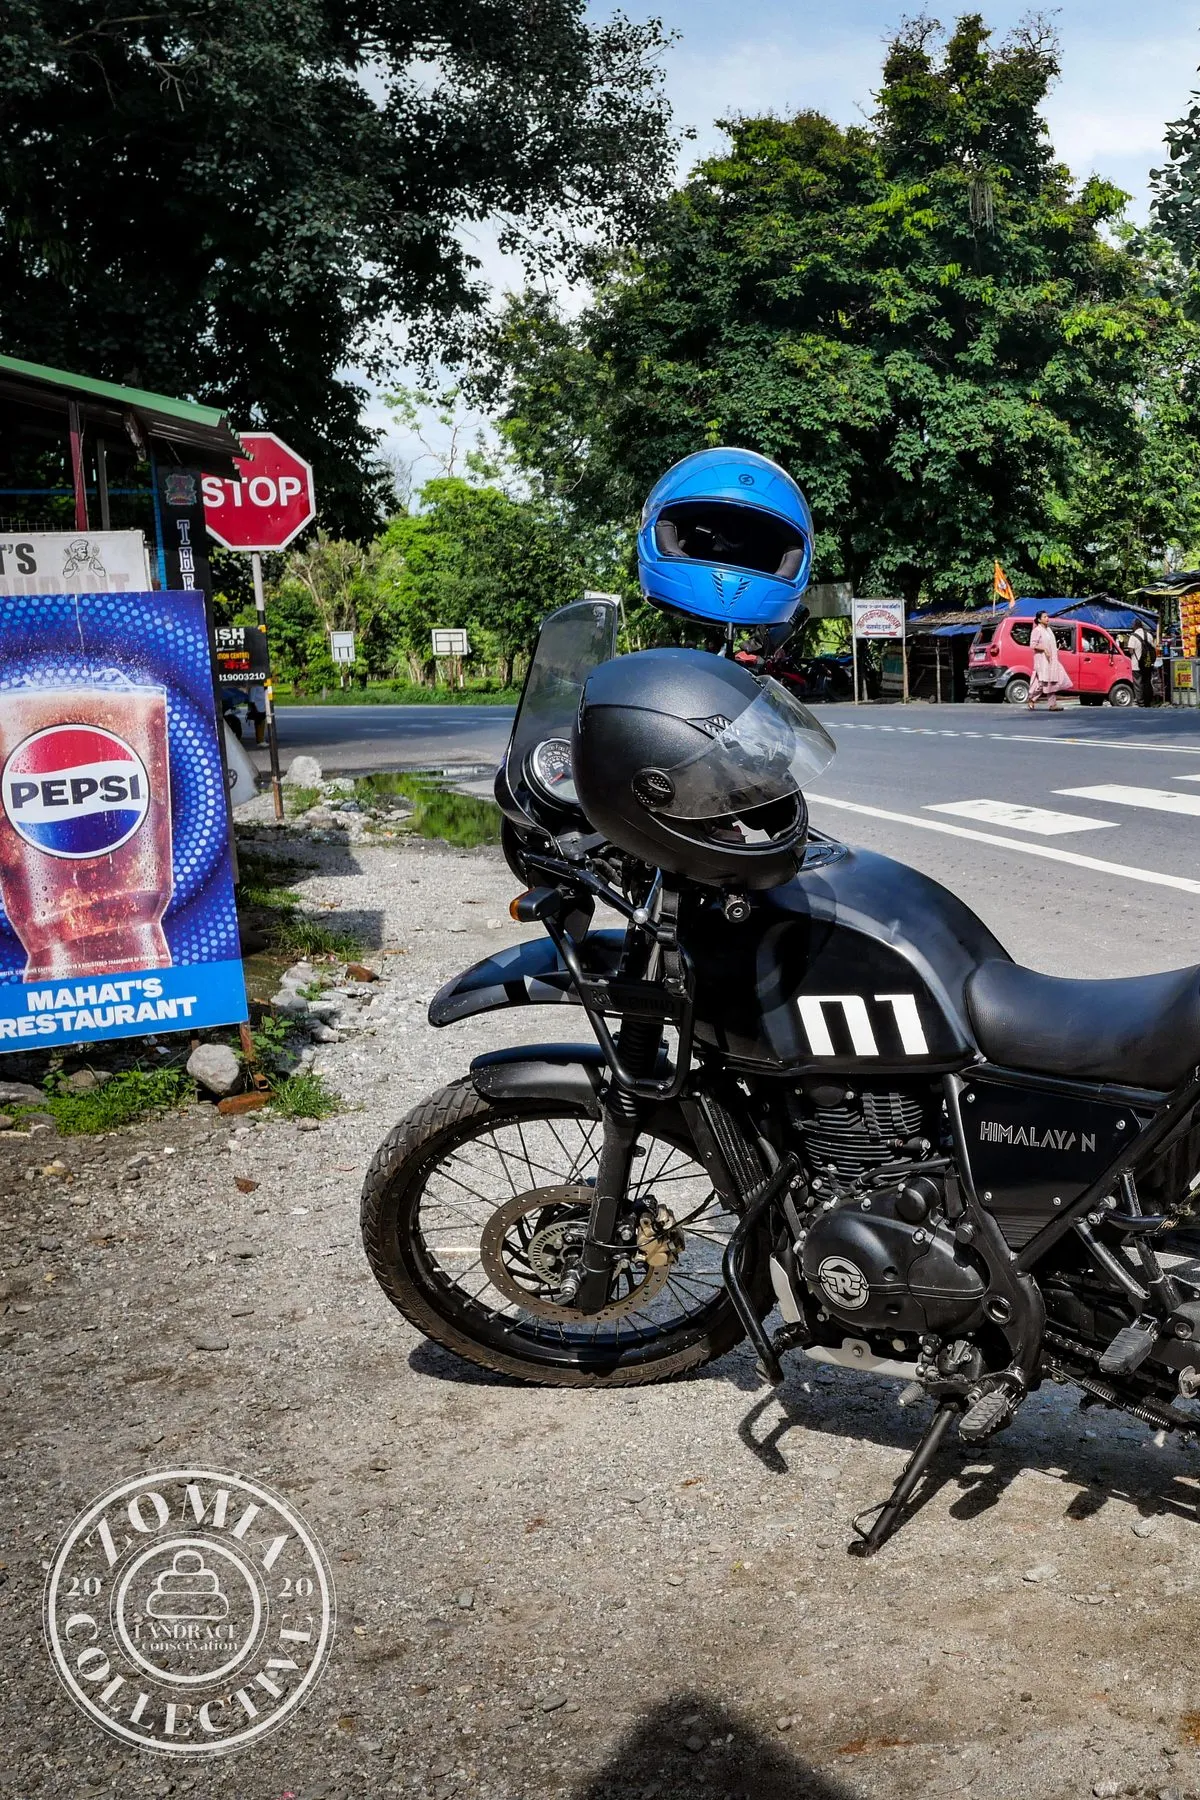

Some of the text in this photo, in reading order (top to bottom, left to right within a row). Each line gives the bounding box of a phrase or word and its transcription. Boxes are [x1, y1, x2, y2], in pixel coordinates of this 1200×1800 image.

[202, 476, 302, 508] STOP
[11, 774, 142, 809] PEPSI
[27, 978, 163, 1012] MAHAT'S
[0, 997, 197, 1039] RESTAURANT
